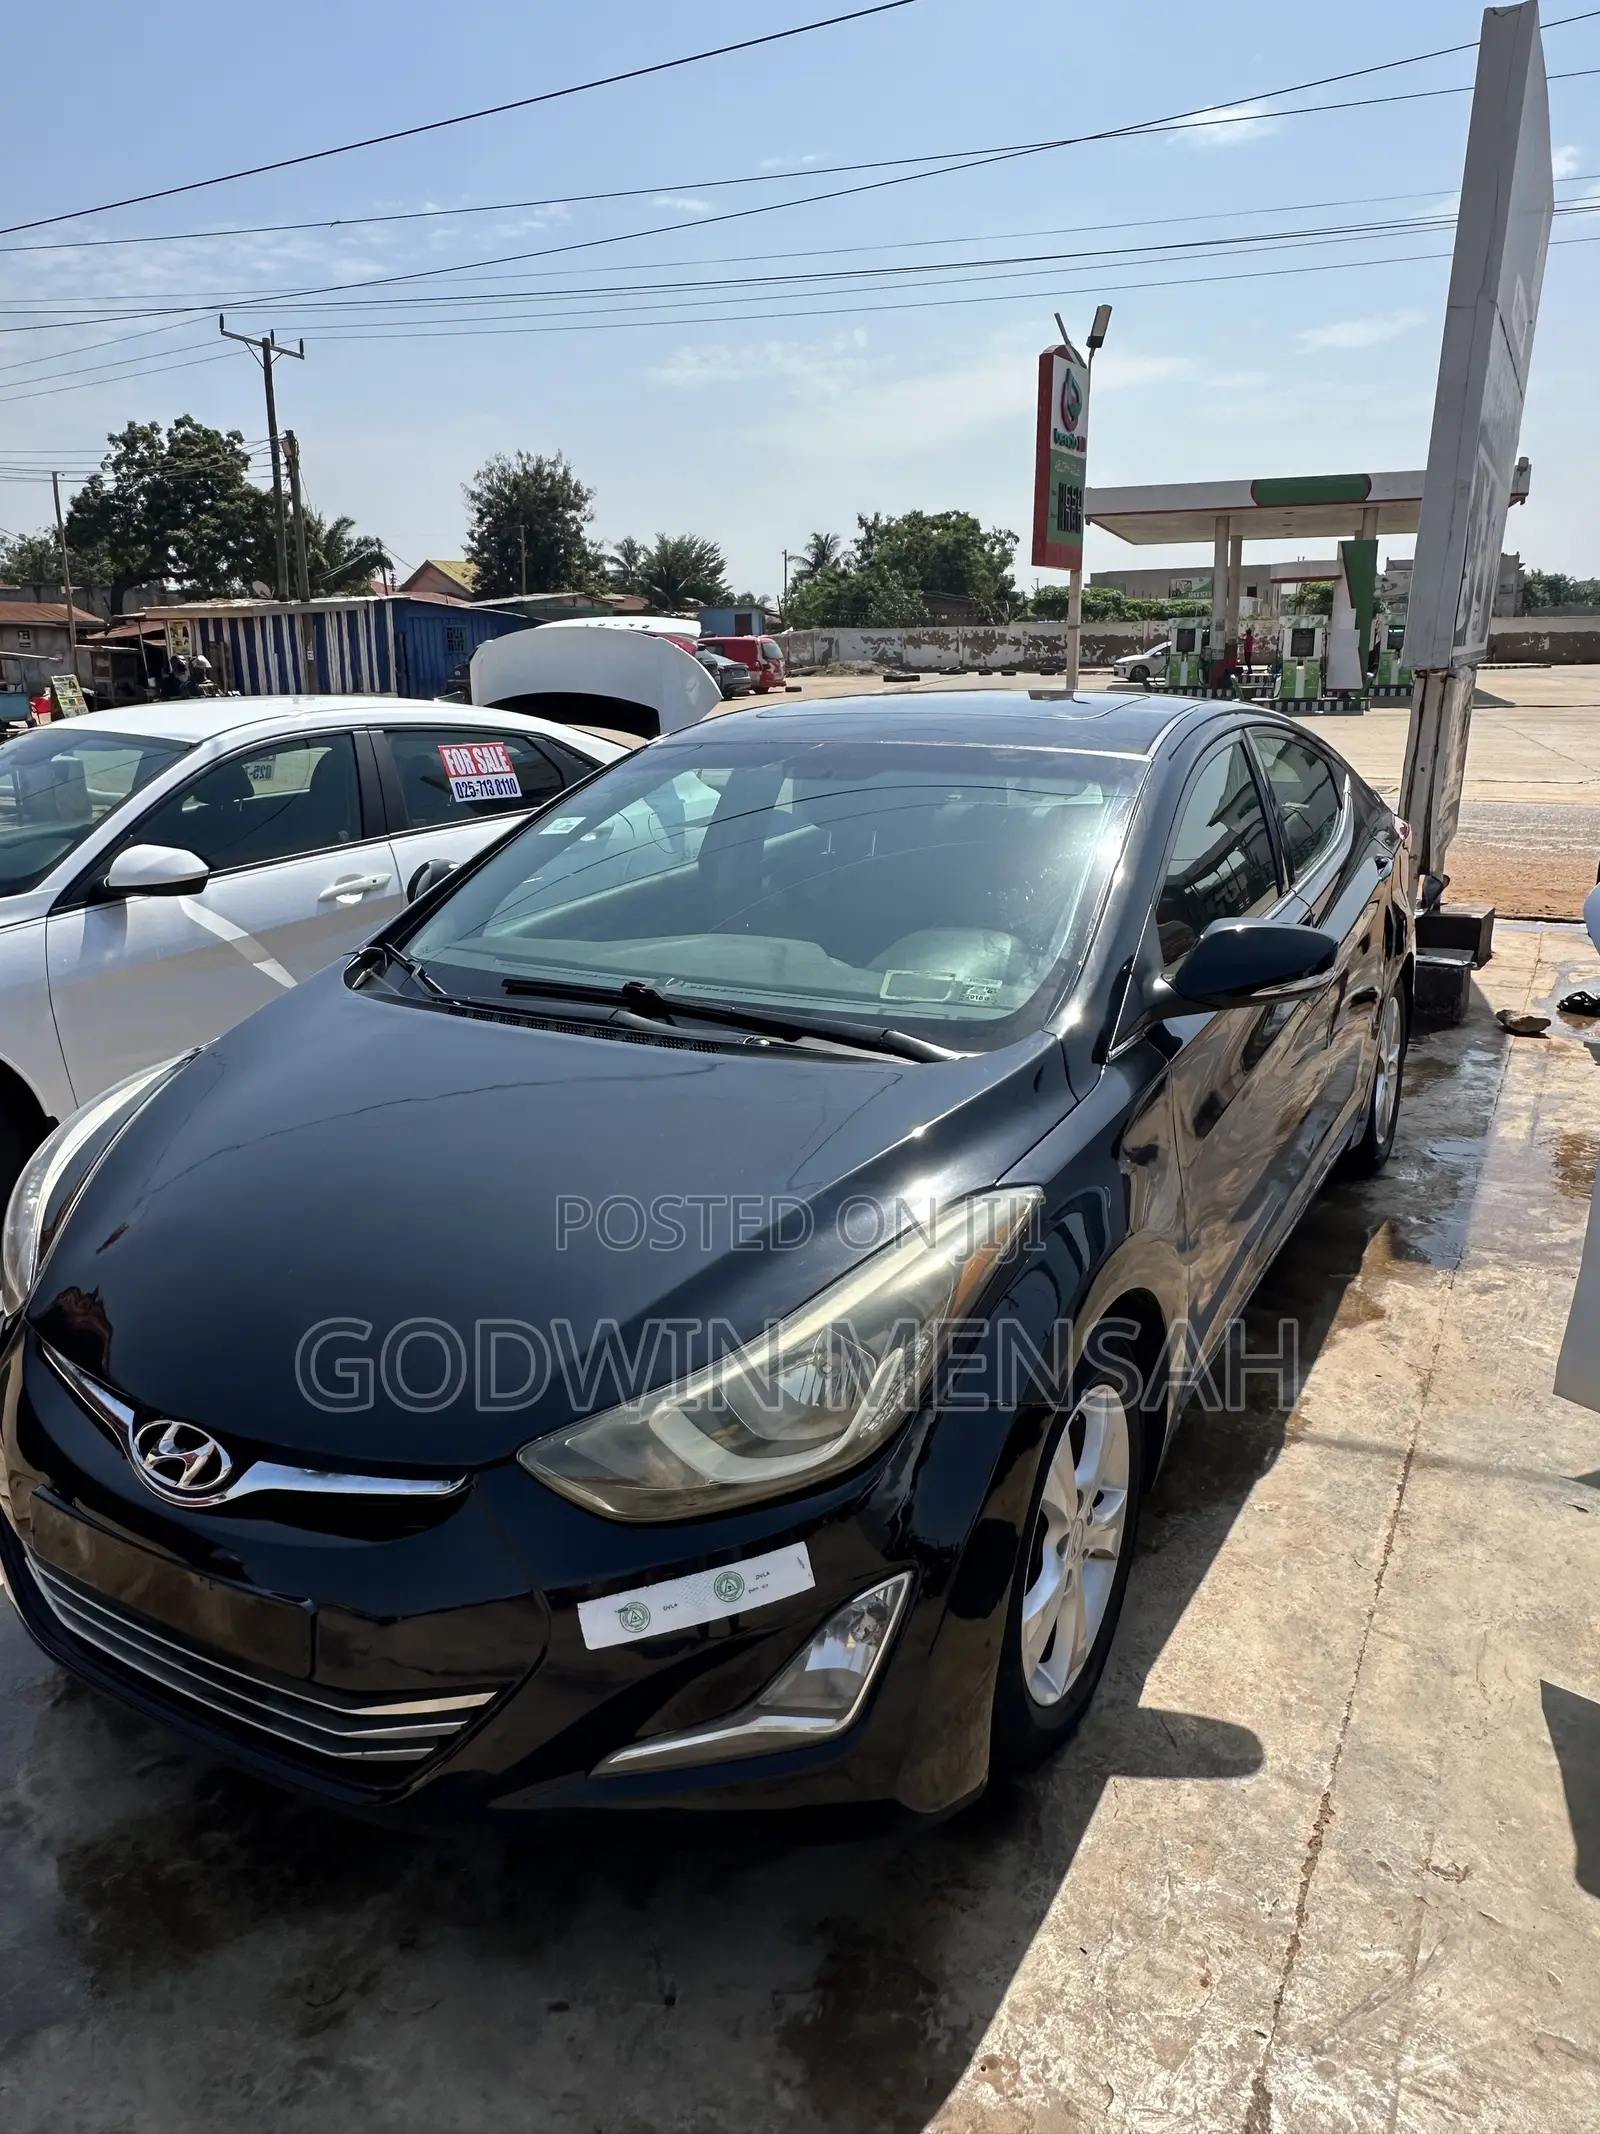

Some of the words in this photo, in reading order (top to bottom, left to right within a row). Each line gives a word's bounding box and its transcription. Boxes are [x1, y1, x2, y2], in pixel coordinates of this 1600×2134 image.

[442, 748, 476, 776] FOR
[472, 746, 511, 774] SALE
[455, 780, 495, 799] 025-713
[495, 778, 518, 796] 8110
